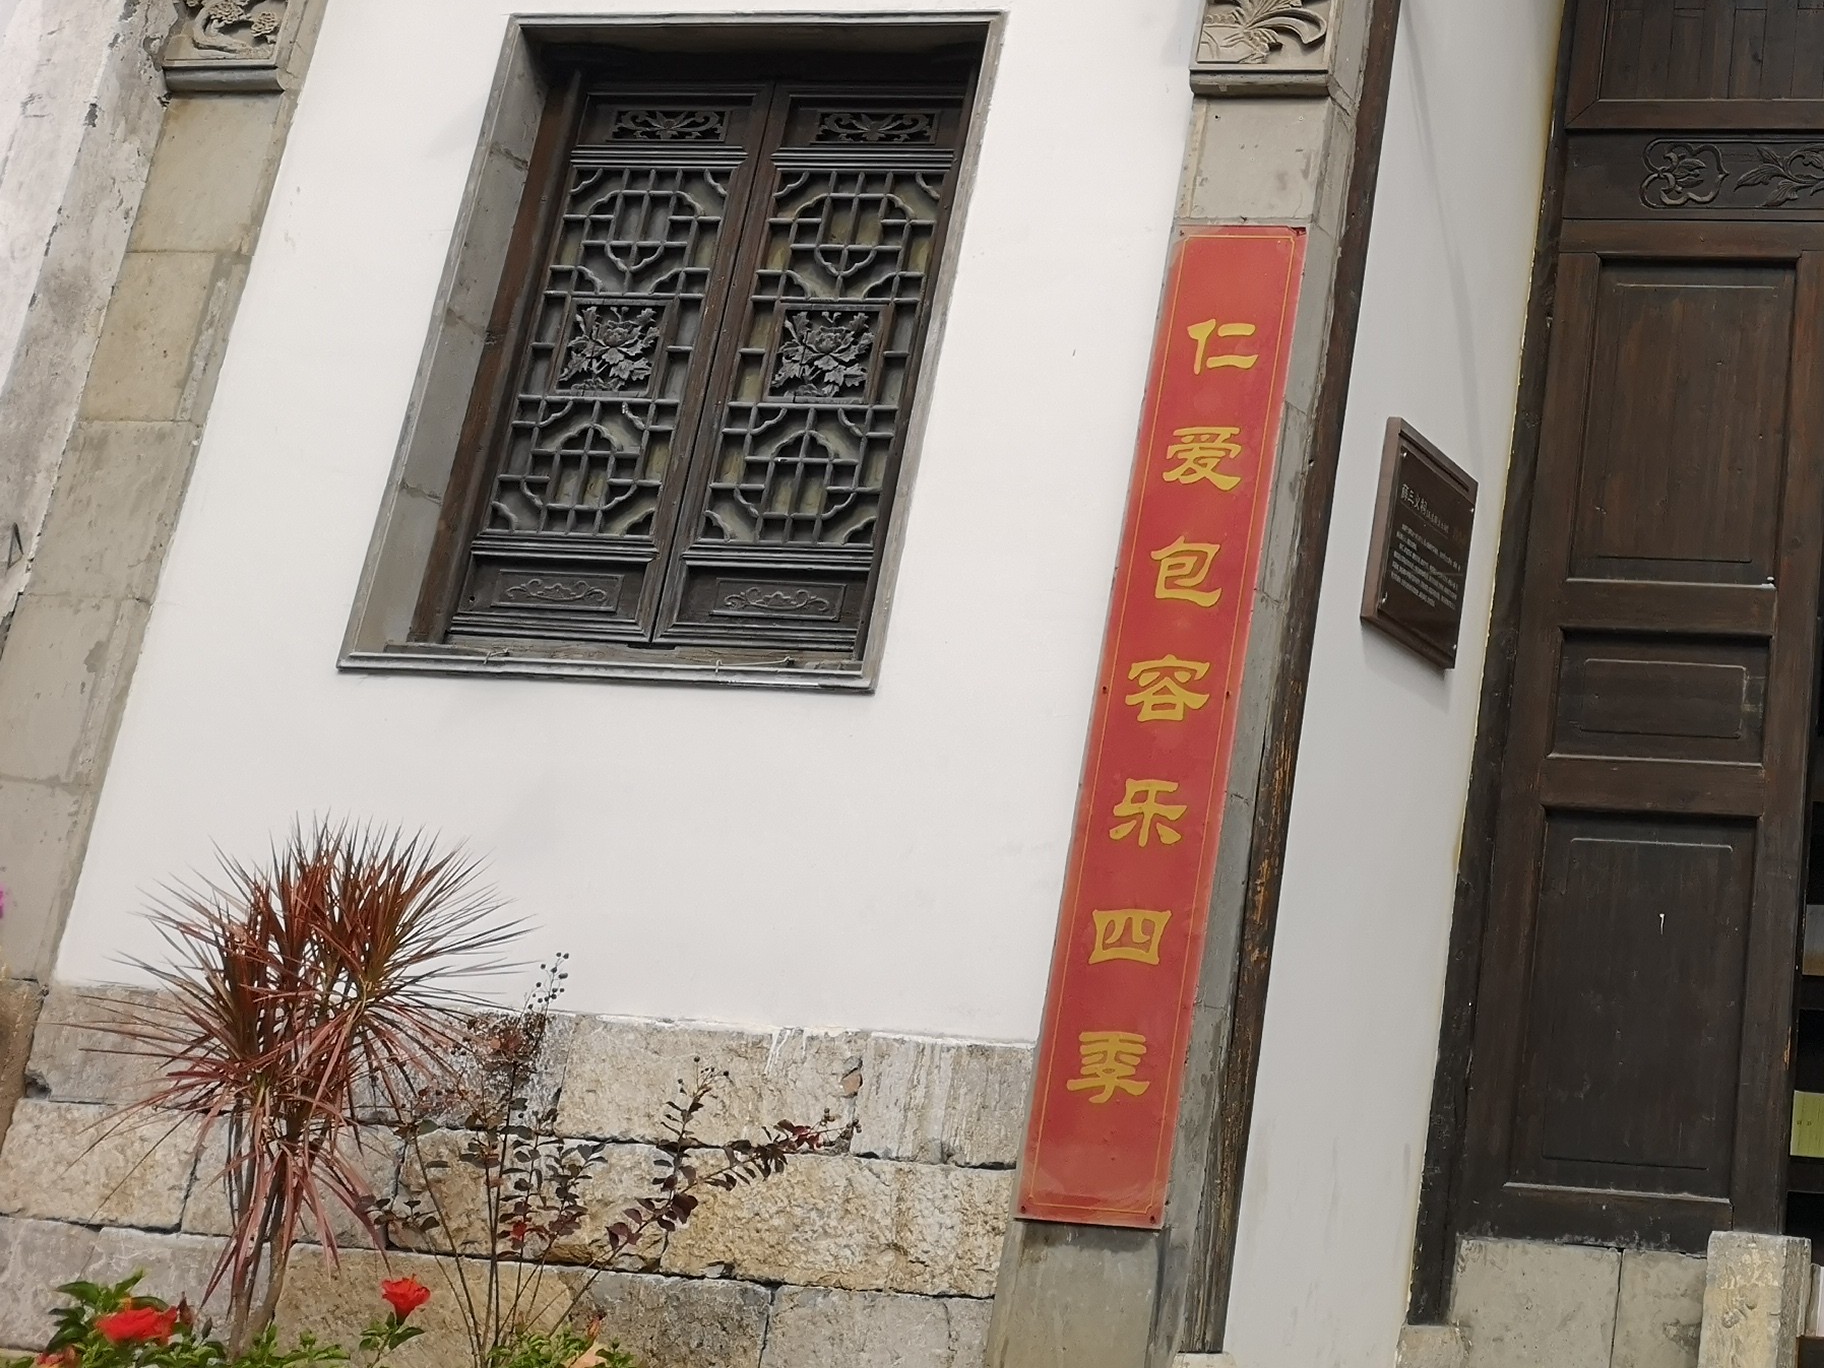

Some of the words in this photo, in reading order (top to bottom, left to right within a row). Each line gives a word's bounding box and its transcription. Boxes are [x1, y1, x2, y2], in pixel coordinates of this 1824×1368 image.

[1066, 318, 1259, 1104] 仁爱包容乐四季
